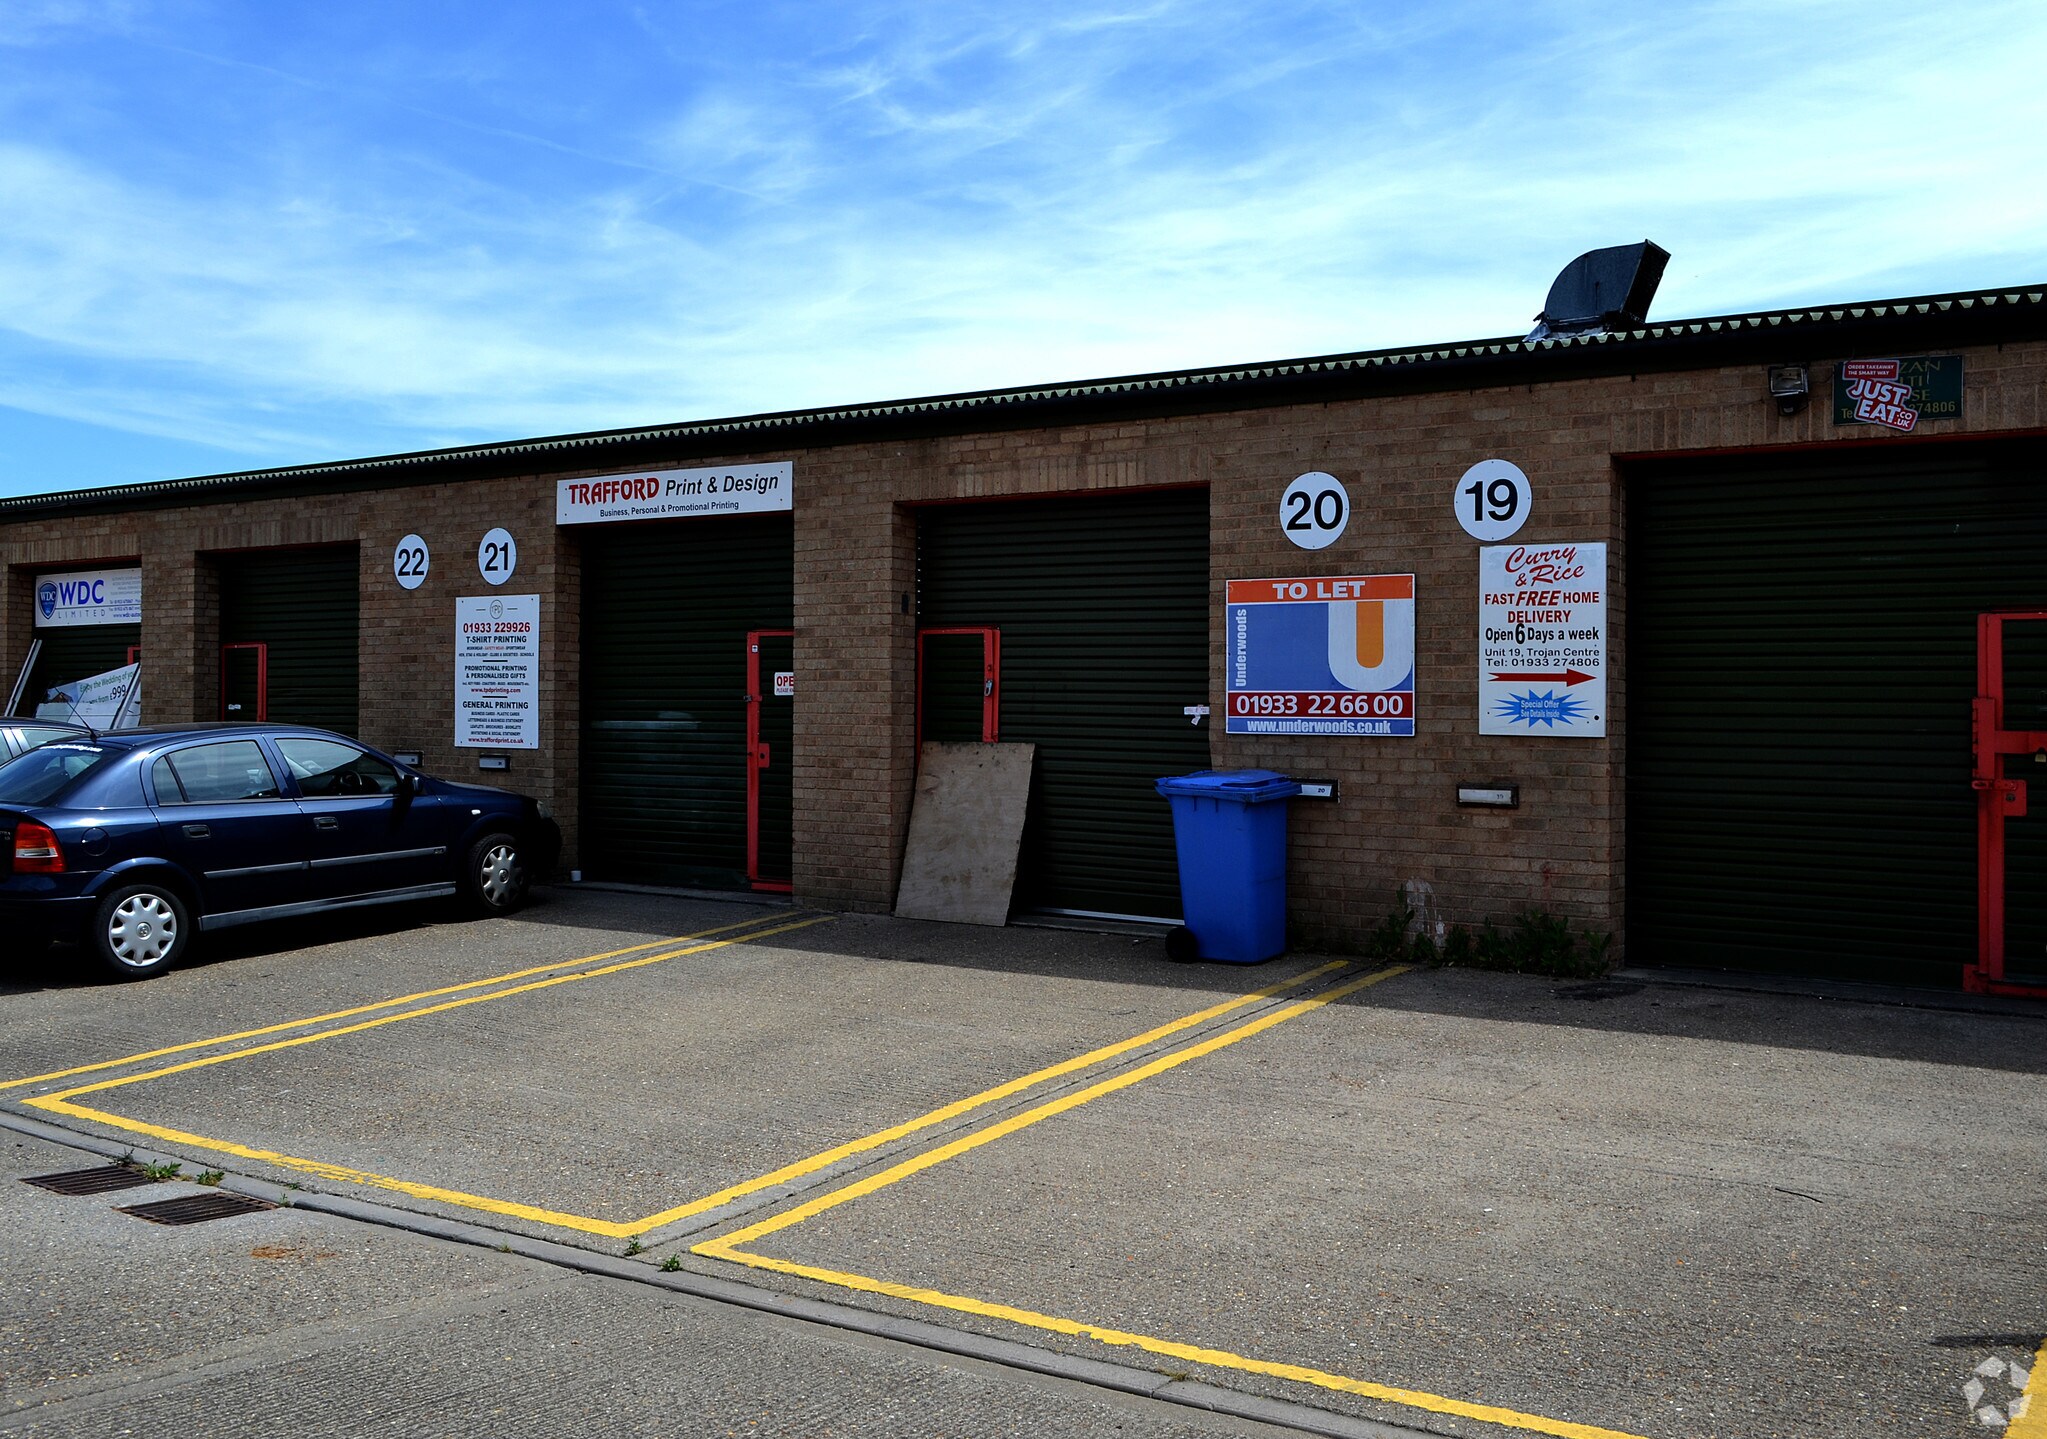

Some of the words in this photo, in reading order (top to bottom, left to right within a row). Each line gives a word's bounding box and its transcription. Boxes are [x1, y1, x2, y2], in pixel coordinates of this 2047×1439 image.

[1851, 379, 1908, 405] JUST
[1841, 408, 1853, 418] Te
[1858, 399, 1902, 424] EAT
[568, 477, 660, 506] TRAFFORD
[665, 478, 703, 497] Print
[706, 476, 718, 494] &
[722, 473, 779, 495] Design
[1464, 478, 1519, 522] 19
[600, 509, 630, 518] Business,
[631, 505, 660, 515] Personal
[660, 504, 667, 513] &
[667, 502, 710, 513] Promotional
[711, 501, 739, 511] Printing
[1285, 489, 1344, 531] 20
[397, 547, 425, 577] 22
[484, 542, 509, 572] 21
[1504, 546, 1578, 573] Curry
[1515, 572, 1527, 587] &
[1528, 564, 1586, 587] Rice
[40, 590, 56, 602] WDC
[58, 579, 105, 606] WDC
[1272, 582, 1308, 600] TO
[1316, 580, 1366, 599] LET
[1484, 593, 1515, 605] FAST
[1515, 590, 1562, 607] FREE
[1563, 592, 1600, 604] HOME
[58, 609, 106, 619] LIMITED
[1507, 610, 1572, 624] DELIVERY
[463, 622, 492, 633] 01933
[494, 622, 531, 633] 229926
[1485, 627, 1514, 644] Open
[1515, 623, 1526, 645] 6
[1527, 627, 1555, 644] Days
[1558, 630, 1565, 640] a
[1568, 626, 1600, 640] week
[466, 635, 492, 643] T-SHIRT
[493, 635, 527, 643] PRINTING
[1235, 608, 1247, 688] Underwoods
[1484, 648, 1506, 657] Unit
[1508, 648, 1524, 658] 19,
[1526, 648, 1561, 659] Trojan
[1563, 647, 1600, 657] Centre
[1486, 658, 1508, 667] Tel:
[1511, 658, 1550, 667] 01933
[1553, 658, 1600, 667] 274806
[776, 676, 794, 687] OPE
[462, 701, 493, 709] GENERAL
[495, 701, 529, 709] PRINTING
[1236, 694, 1298, 714] 01933
[1520, 700, 1543, 709] Special
[1543, 699, 1560, 708] Offer
[1247, 719, 1392, 734] www.underwoods.co.uk
